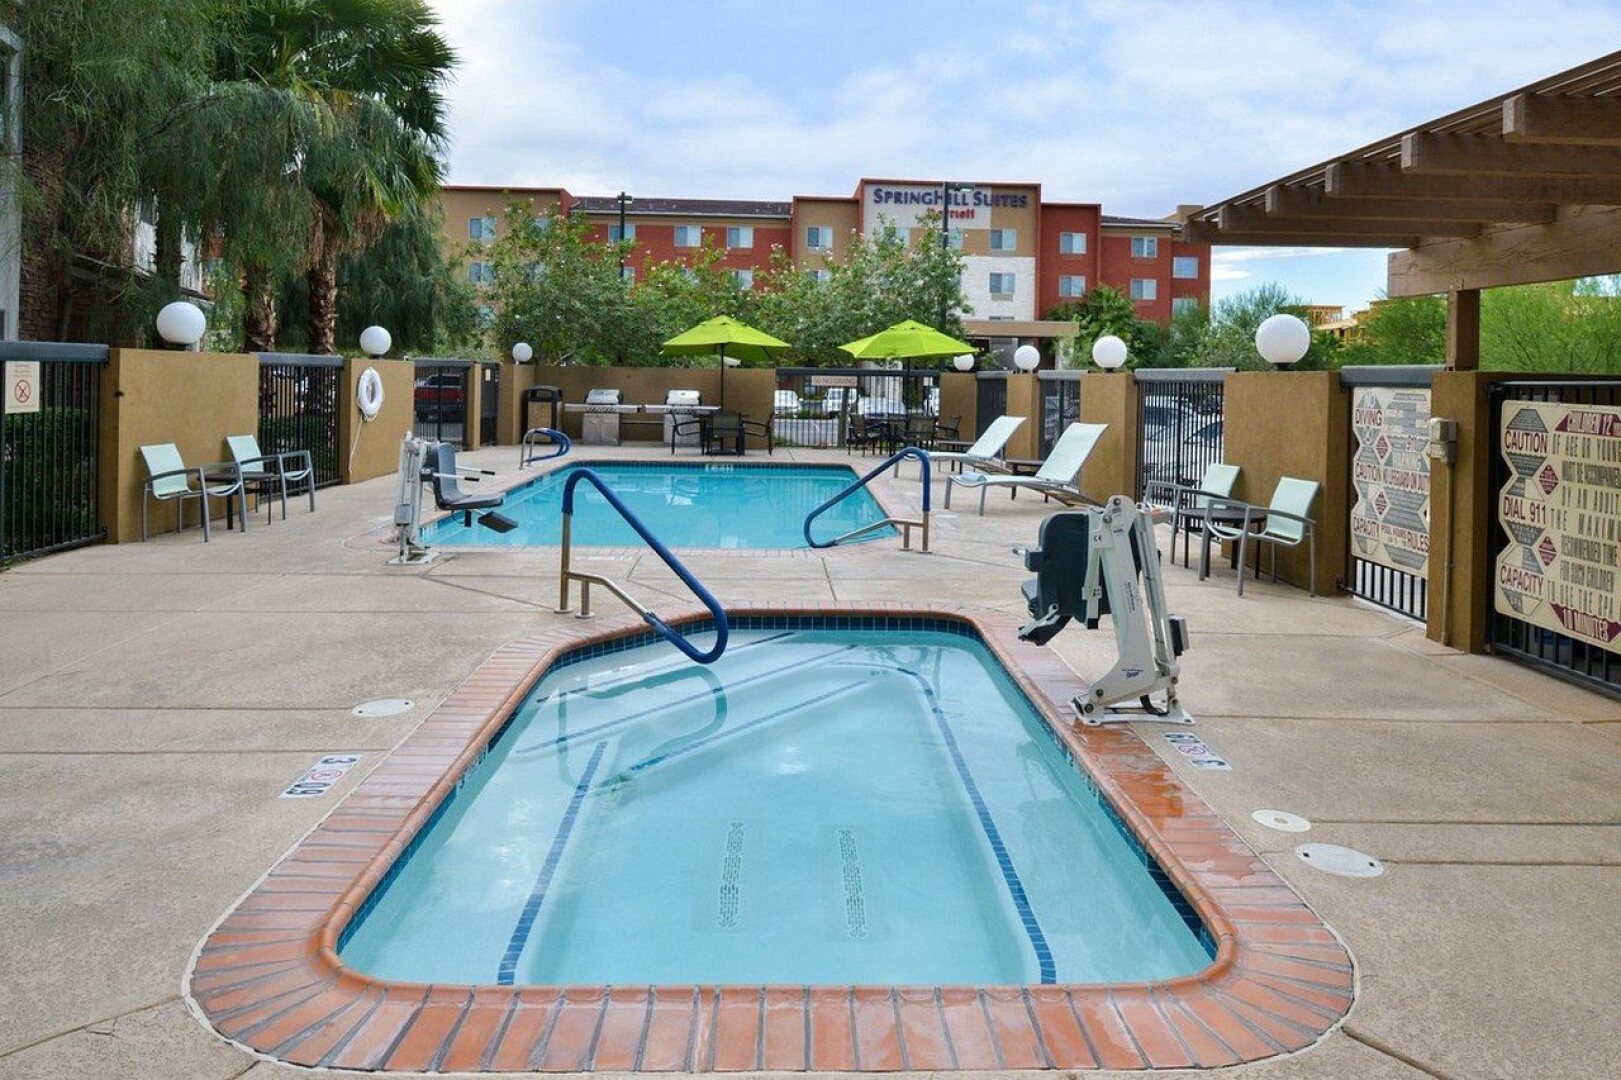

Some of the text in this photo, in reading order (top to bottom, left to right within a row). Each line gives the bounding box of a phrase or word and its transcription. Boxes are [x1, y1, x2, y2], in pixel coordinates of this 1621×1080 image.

[974, 191, 1028, 208] SUITES
[1355, 408, 1383, 426] DIVING
[1568, 411, 1601, 434] CHILDREN
[1602, 414, 1614, 435] 12
[1505, 430, 1549, 454] CAUTION
[1552, 434, 1561, 455] OF
[1565, 435, 1579, 458] AGE
[1356, 462, 1382, 483] CAUTION
[1576, 462, 1584, 484] BE
[1503, 496, 1546, 525] DIAL 911
[1551, 508, 1568, 531] THE
[1354, 516, 1380, 541] CAPACITY
[1408, 531, 1428, 554] RULES
[1500, 565, 1545, 597] CAPACITY
[1574, 611, 1608, 643] MINUTES
